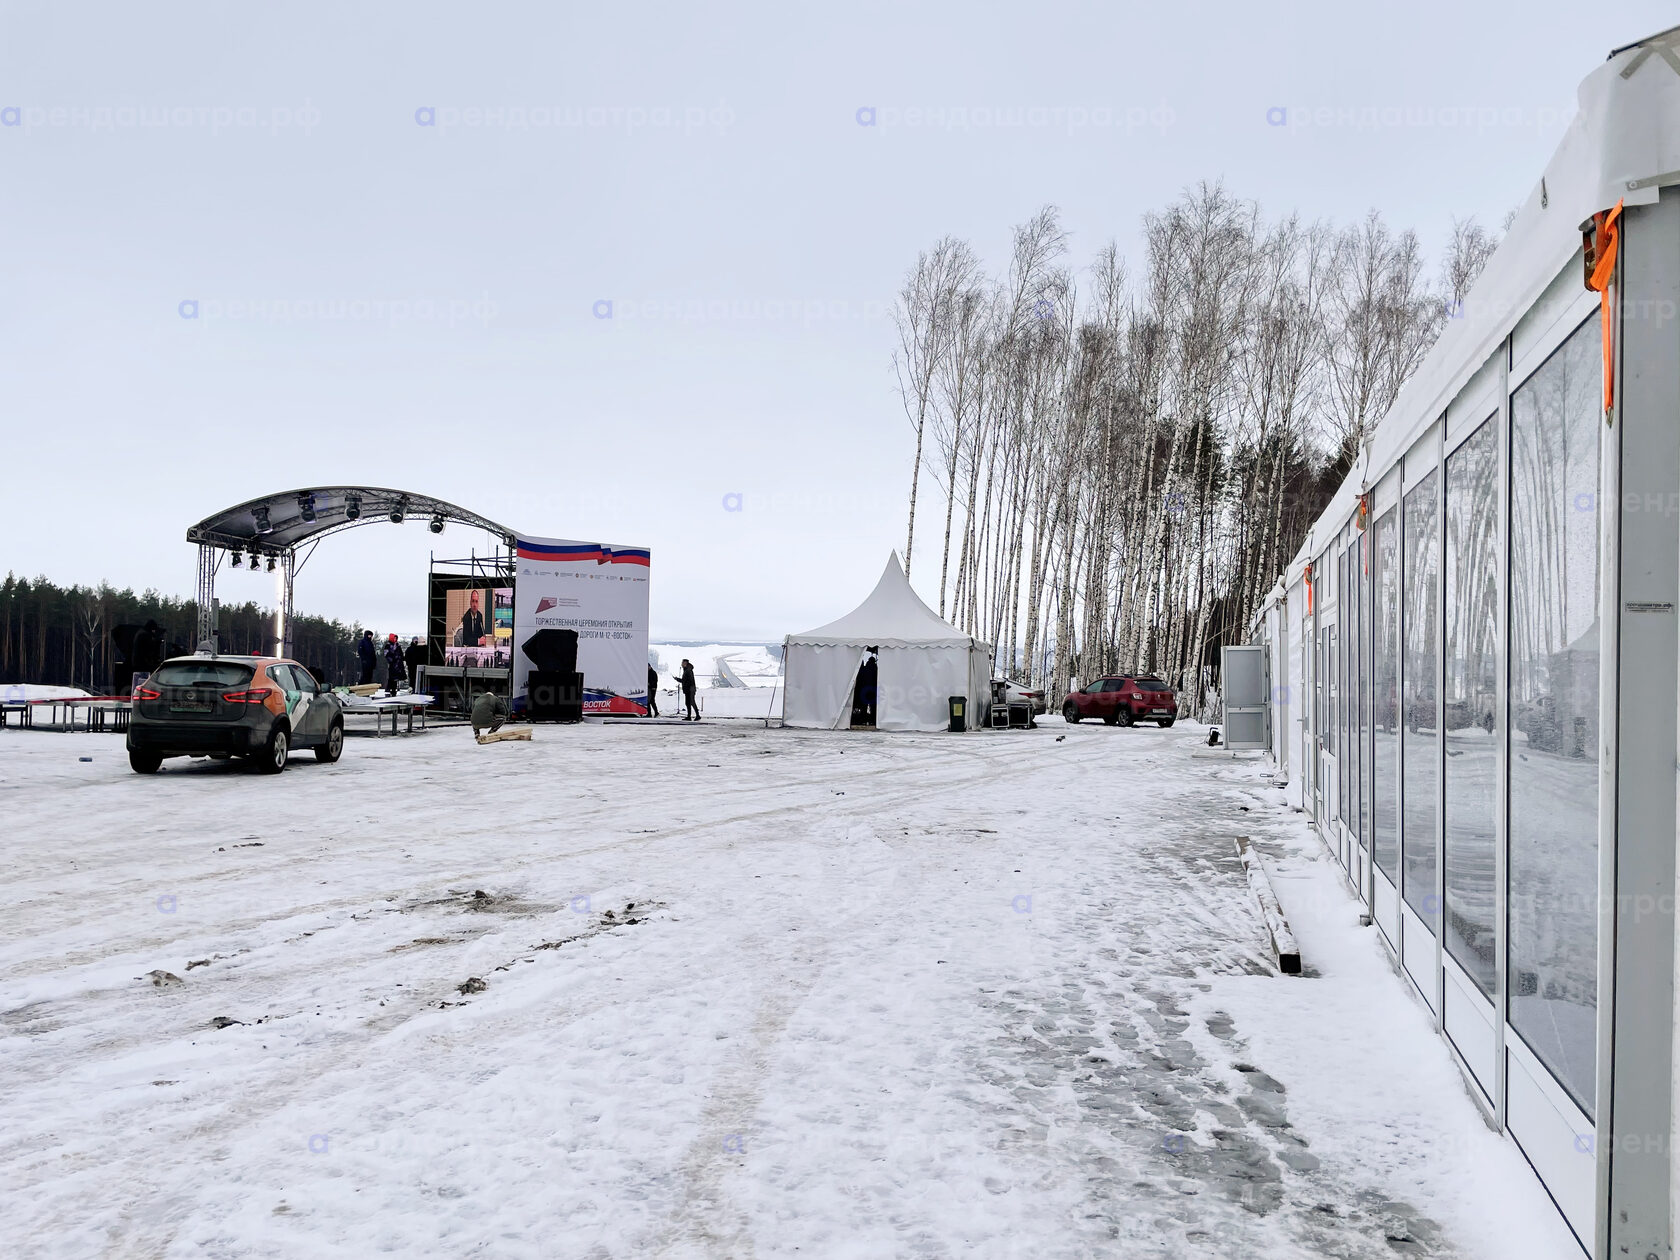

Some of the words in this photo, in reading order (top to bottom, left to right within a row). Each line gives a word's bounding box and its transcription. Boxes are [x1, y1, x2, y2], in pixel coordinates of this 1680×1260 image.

[535, 617, 578, 627] ТОРЖЕСТВЕННАЯ
[578, 619, 607, 629] ЦЕРЕМОНИЯ
[608, 620, 633, 629] ОТКРЫТИЯ
[580, 630, 599, 639] ДОРОГИ
[583, 700, 612, 709] ВОСТОК
